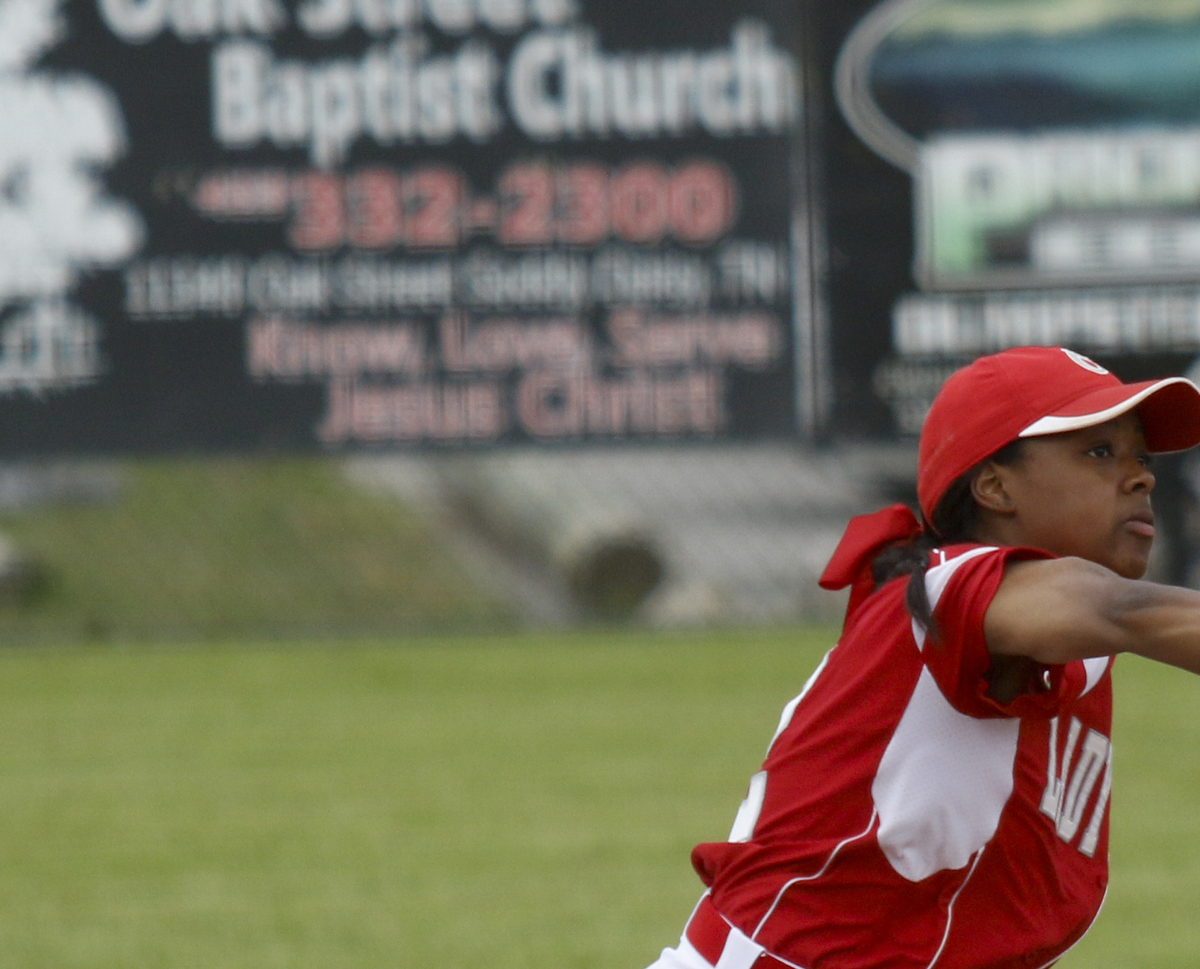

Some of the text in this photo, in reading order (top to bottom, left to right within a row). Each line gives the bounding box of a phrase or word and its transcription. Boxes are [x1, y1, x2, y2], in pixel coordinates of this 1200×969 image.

[212, 26, 798, 165] Baptist Church
[292, 163, 738, 249] 332-2300
[319, 371, 724, 440] Jesus Christ
